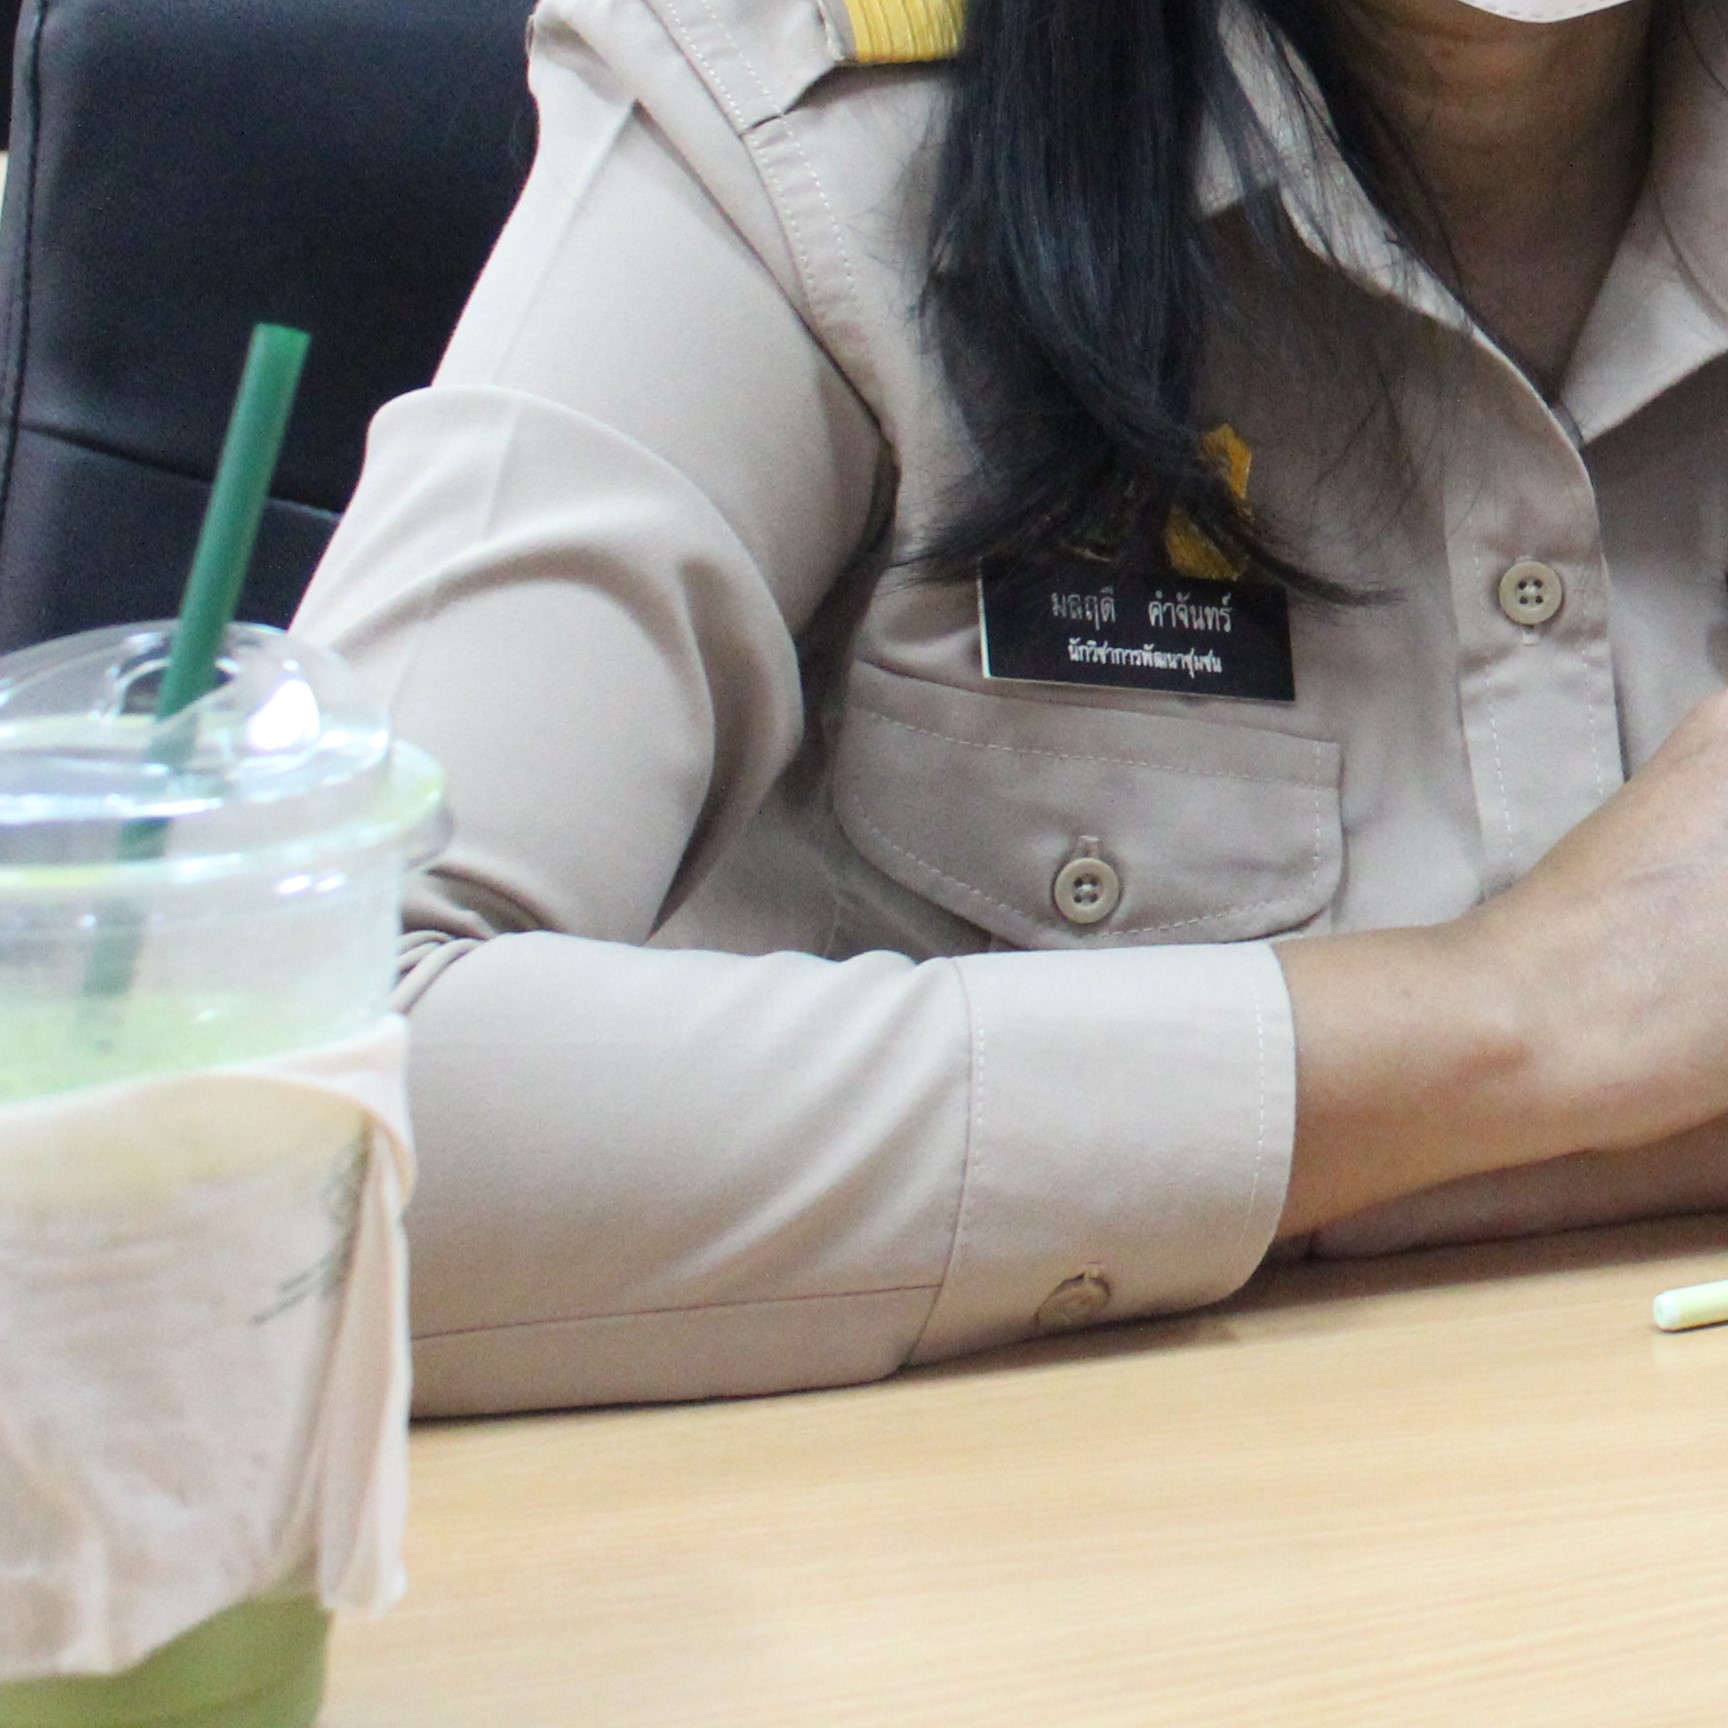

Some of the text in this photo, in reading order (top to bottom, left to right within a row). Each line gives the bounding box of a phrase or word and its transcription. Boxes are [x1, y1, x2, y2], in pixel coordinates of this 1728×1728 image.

[1147, 589, 1233, 633] คำจันทร์
[1067, 637, 1223, 679] นักวิชาการพัฒนาชุมชน
